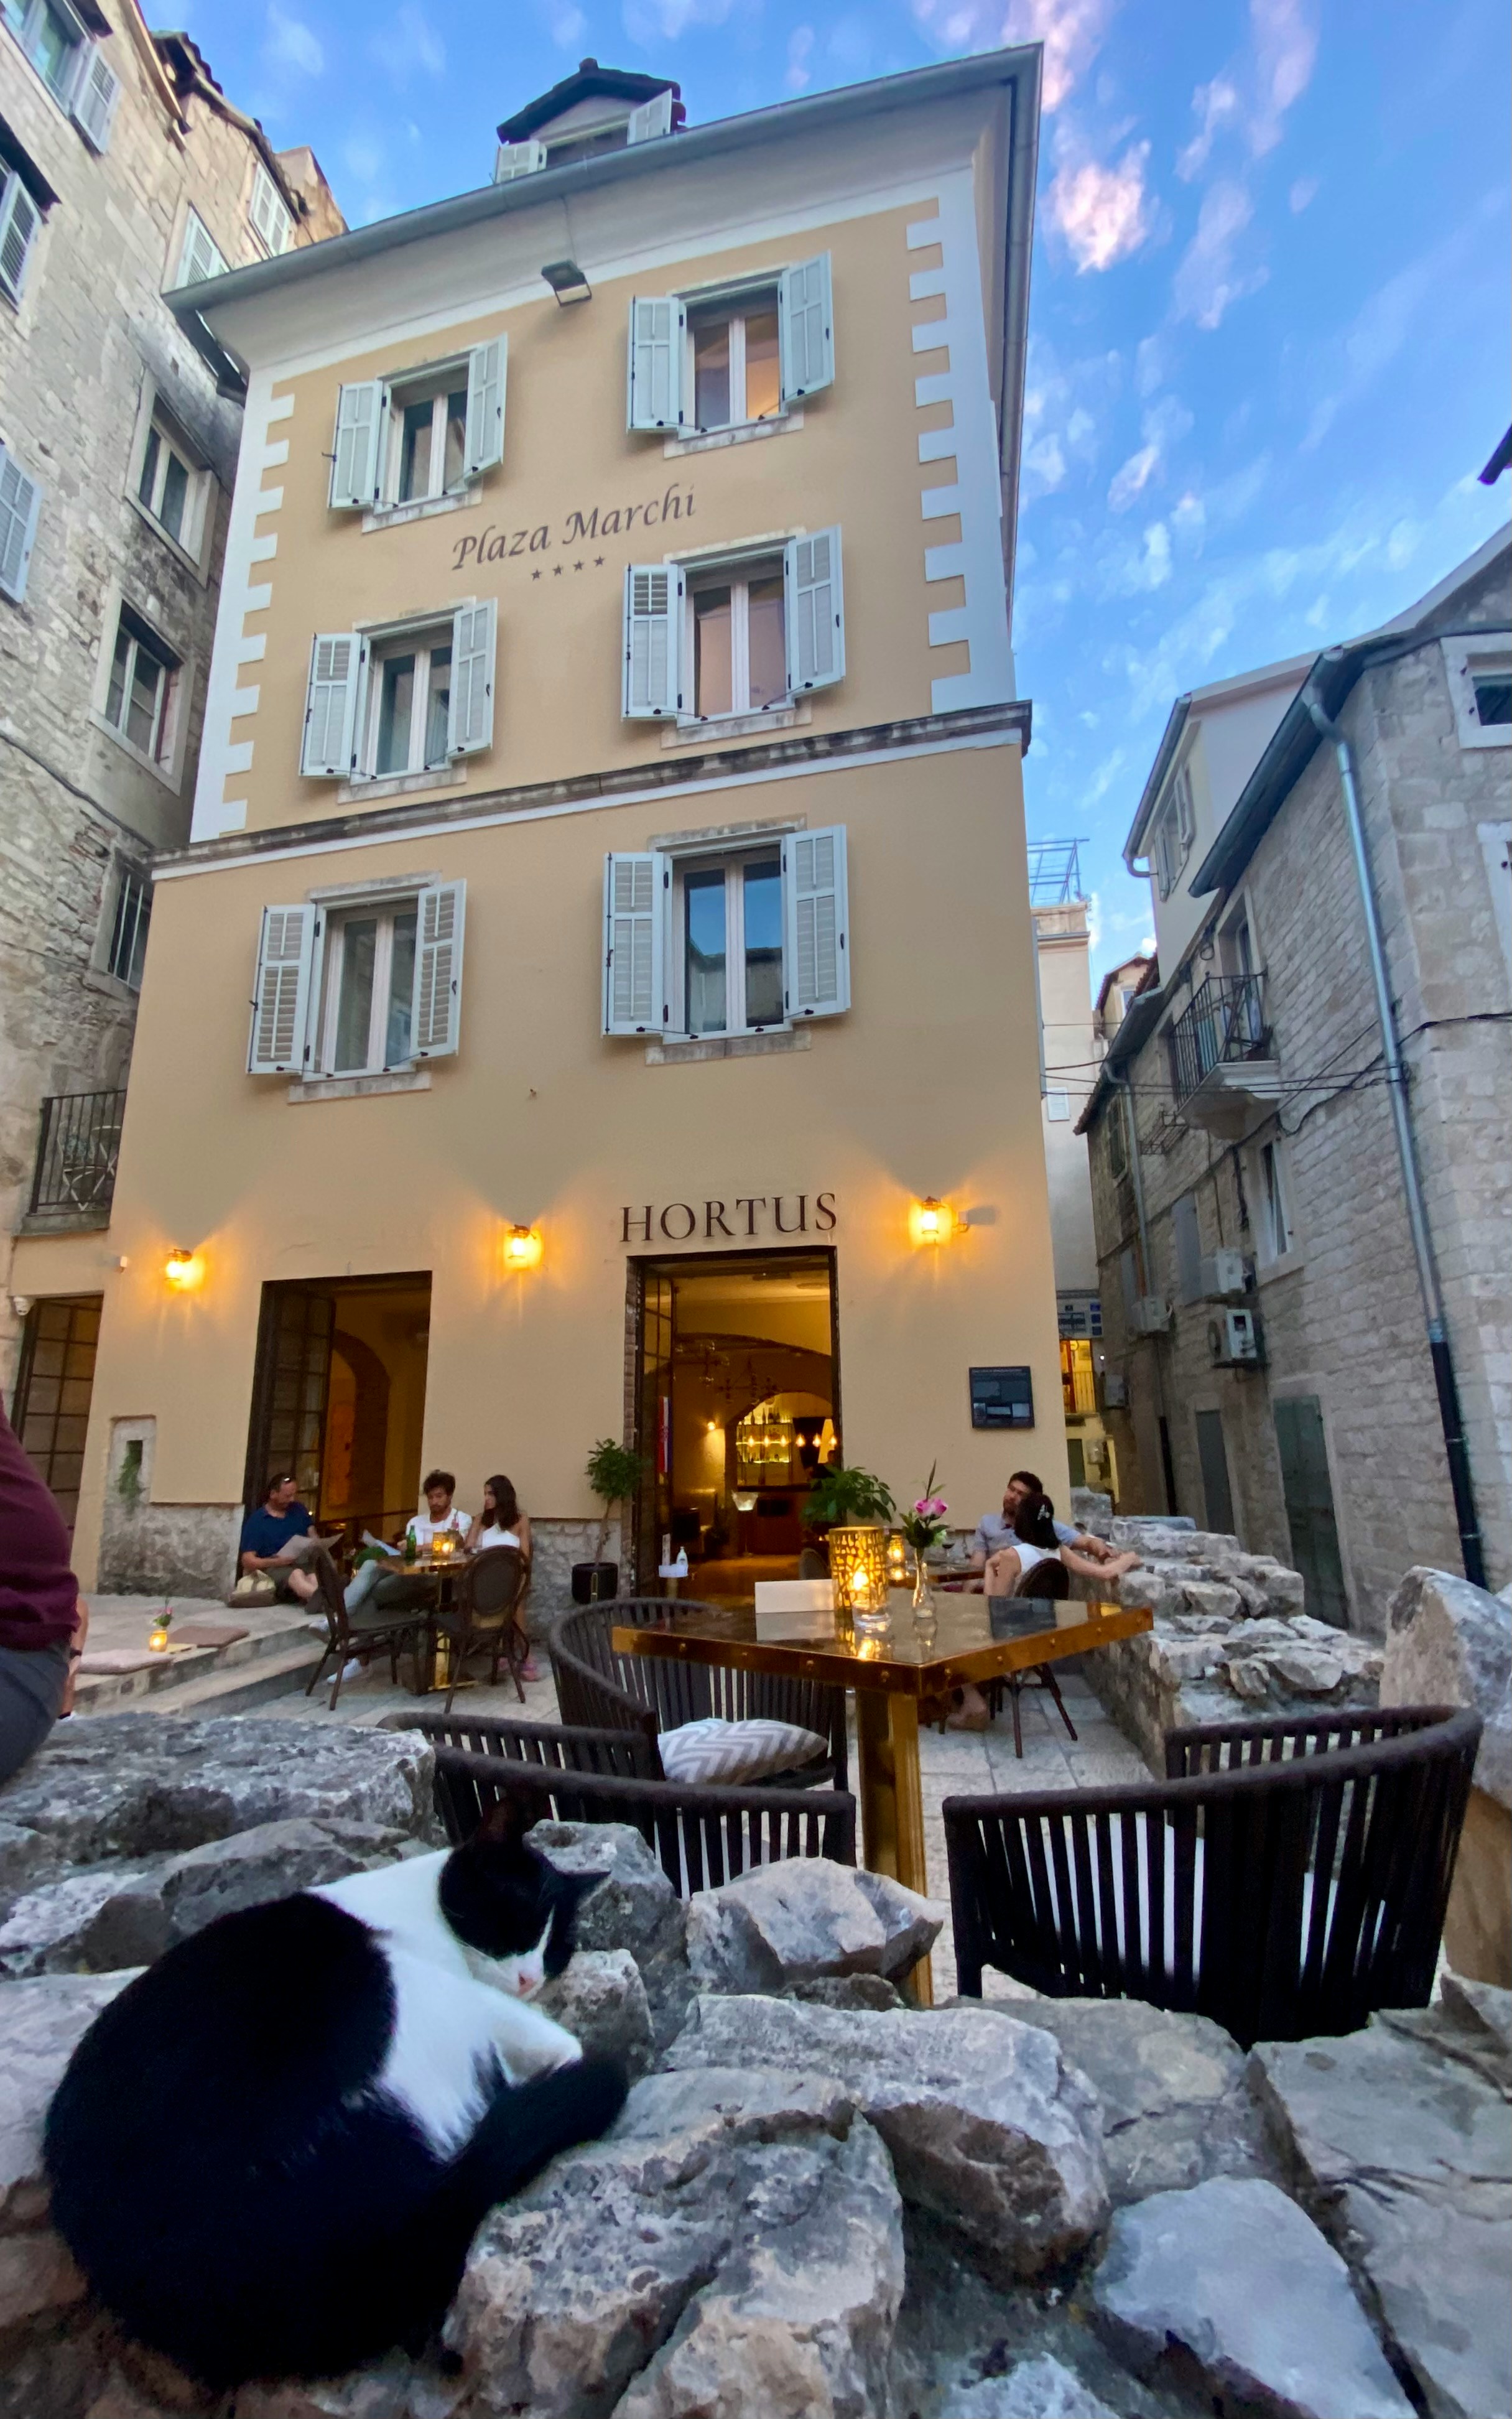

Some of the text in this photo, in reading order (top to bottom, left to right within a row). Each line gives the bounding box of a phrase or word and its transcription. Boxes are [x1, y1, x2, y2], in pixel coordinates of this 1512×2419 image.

[452, 483, 696, 570] Plaza Marchi
[619, 1192, 837, 1242] HORTUS
